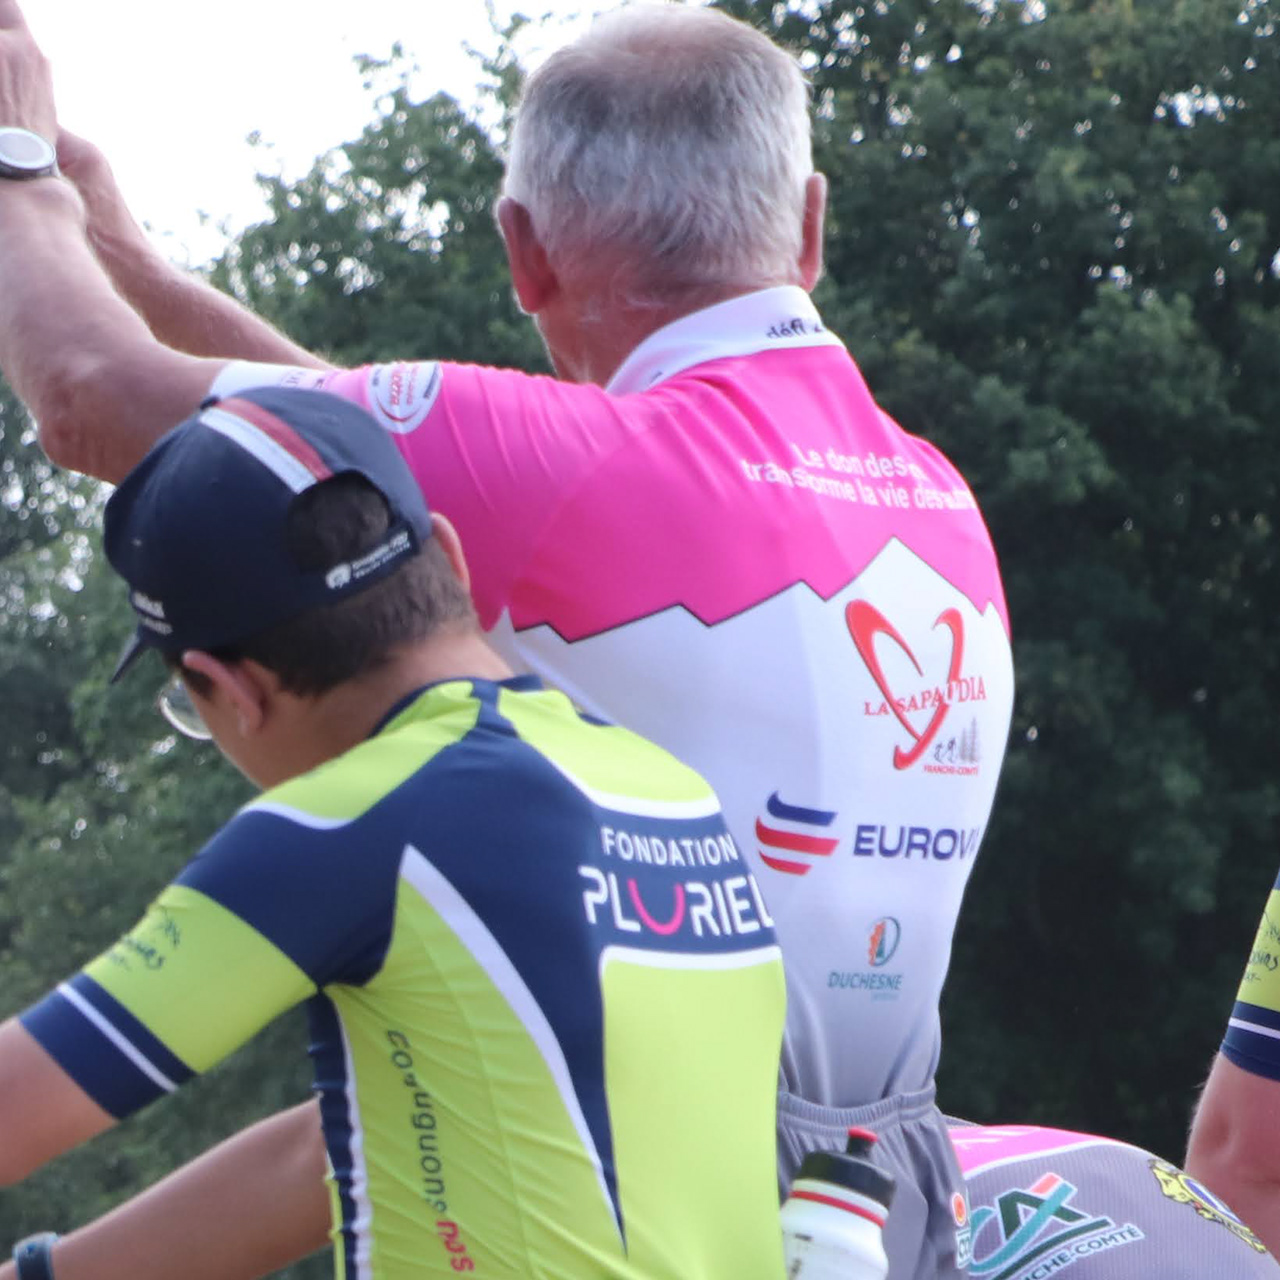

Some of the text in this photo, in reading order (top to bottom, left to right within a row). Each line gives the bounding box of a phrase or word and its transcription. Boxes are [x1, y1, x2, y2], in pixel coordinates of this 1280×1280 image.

[827, 448, 864, 477] don
[865, 452, 907, 478] des
[856, 479, 878, 505] la
[879, 482, 910, 509] vie
[600, 825, 739, 867] FONDATION
[853, 823, 980, 861] EUROV
[580, 866, 775, 938] PLURIEL
